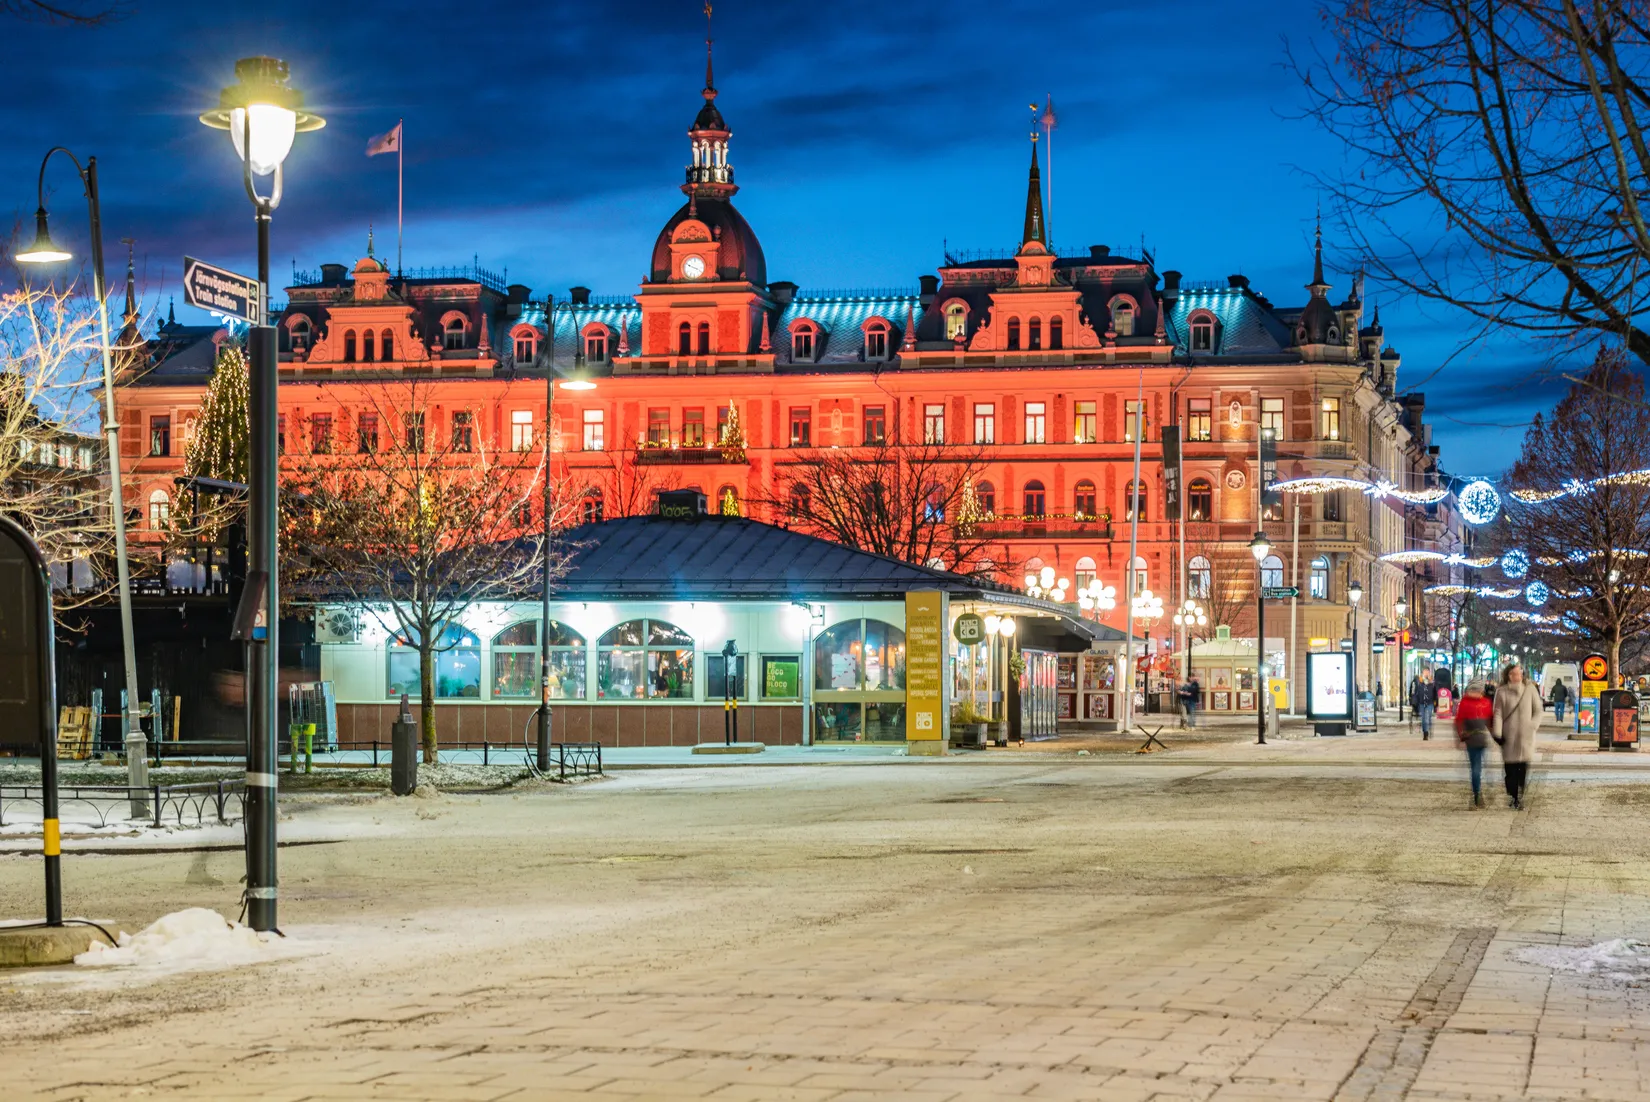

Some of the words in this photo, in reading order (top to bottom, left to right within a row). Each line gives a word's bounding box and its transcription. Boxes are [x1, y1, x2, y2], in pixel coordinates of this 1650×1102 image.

[196, 270, 248, 298] Järnvägsstation
[195, 285, 213, 303] Train
[214, 293, 237, 312] station
